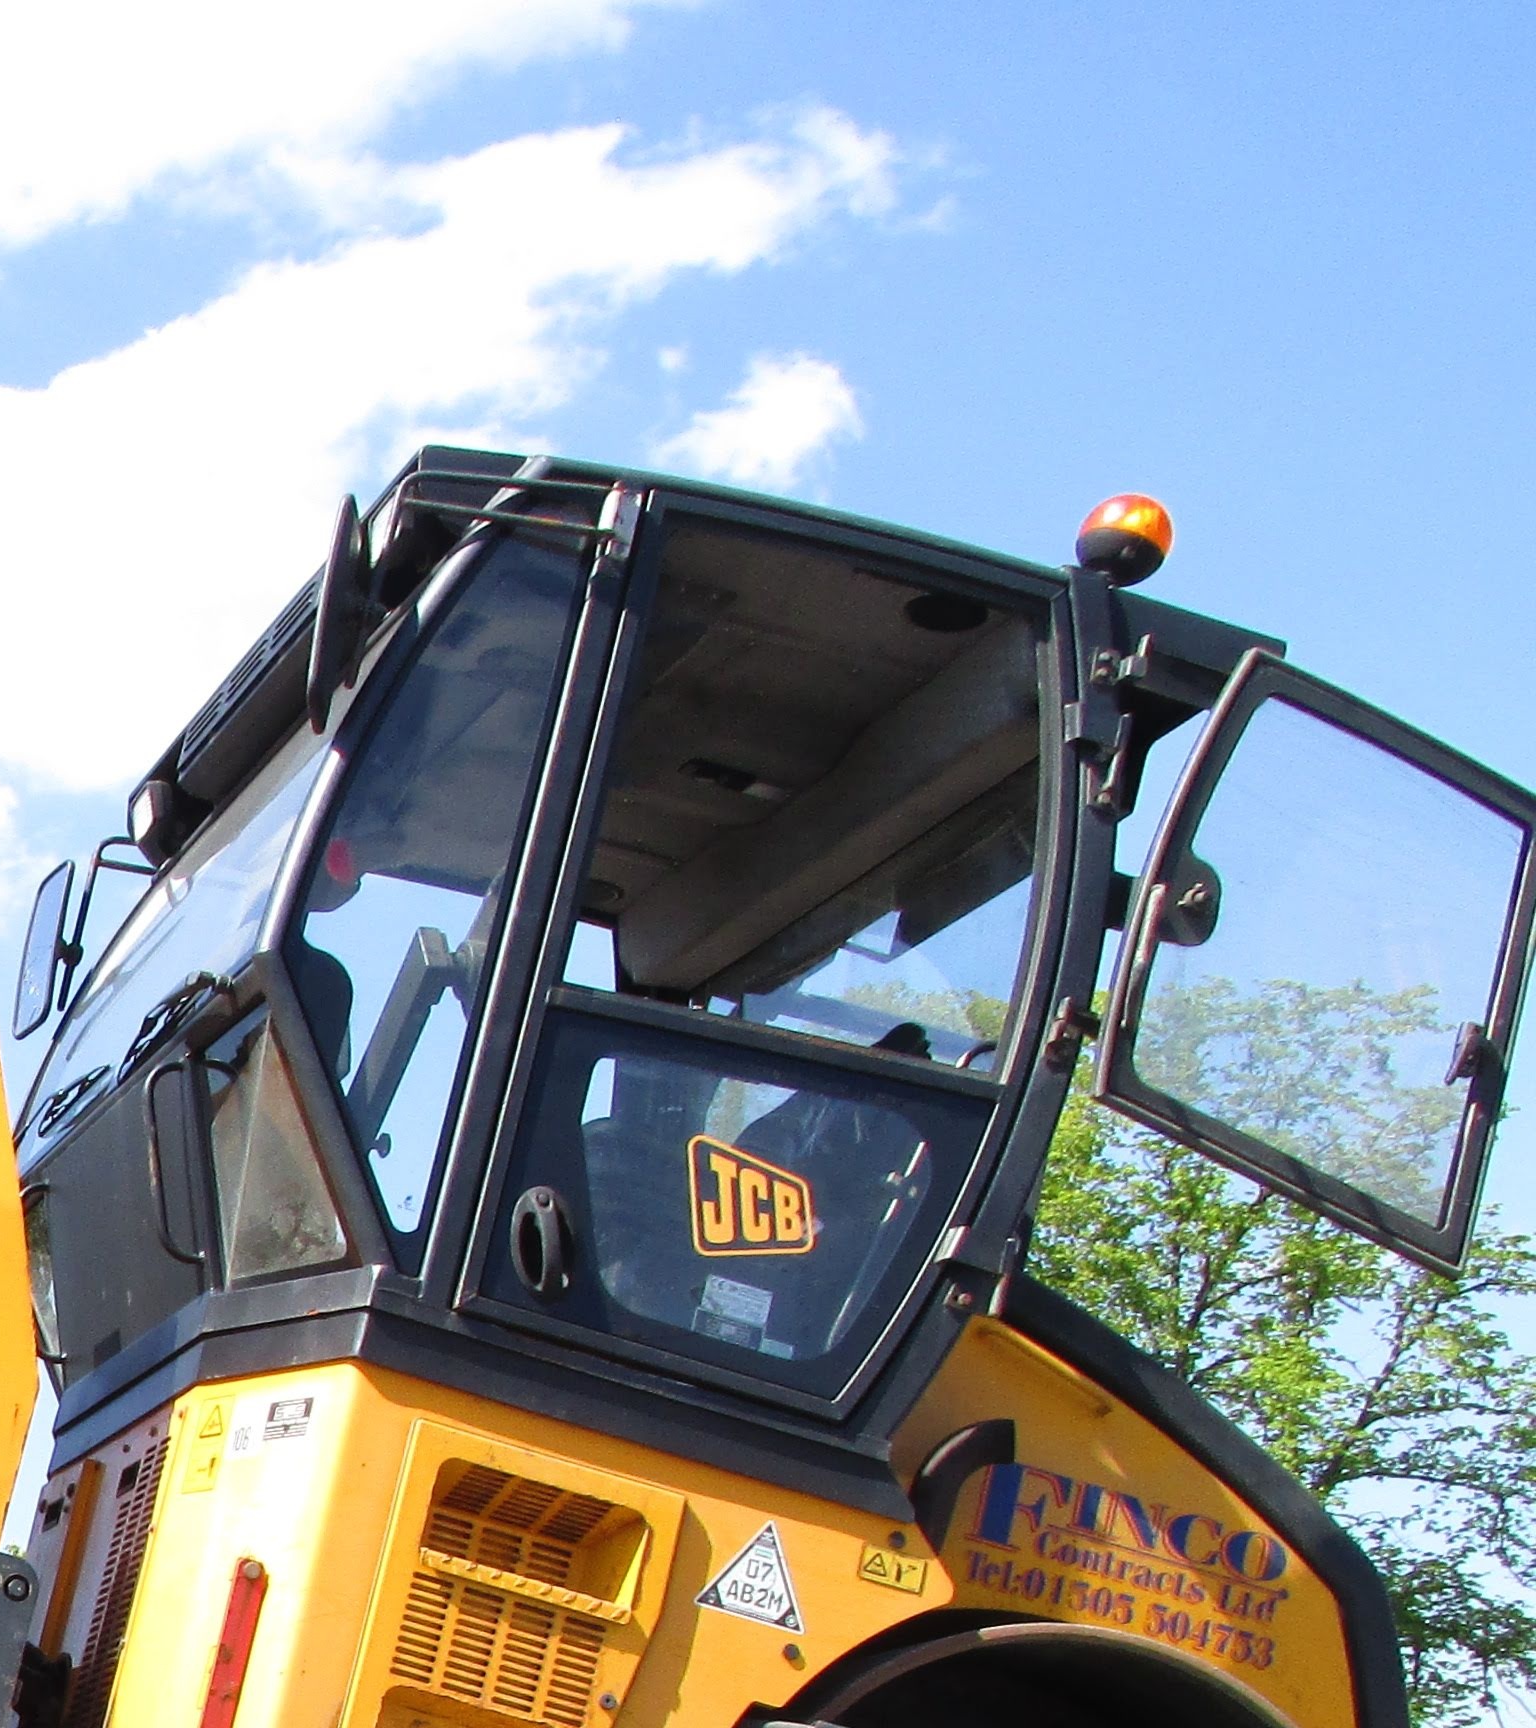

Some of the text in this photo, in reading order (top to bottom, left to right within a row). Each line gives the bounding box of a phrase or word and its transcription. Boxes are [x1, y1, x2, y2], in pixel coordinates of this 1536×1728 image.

[702, 1152, 803, 1244] JCB
[965, 1463, 1286, 1581] FINCO
[726, 1579, 785, 1614] AB2M
[964, 1550, 1275, 1670] Tel:01505 504753
[1033, 1530, 1280, 1623] Contracts Ltd
